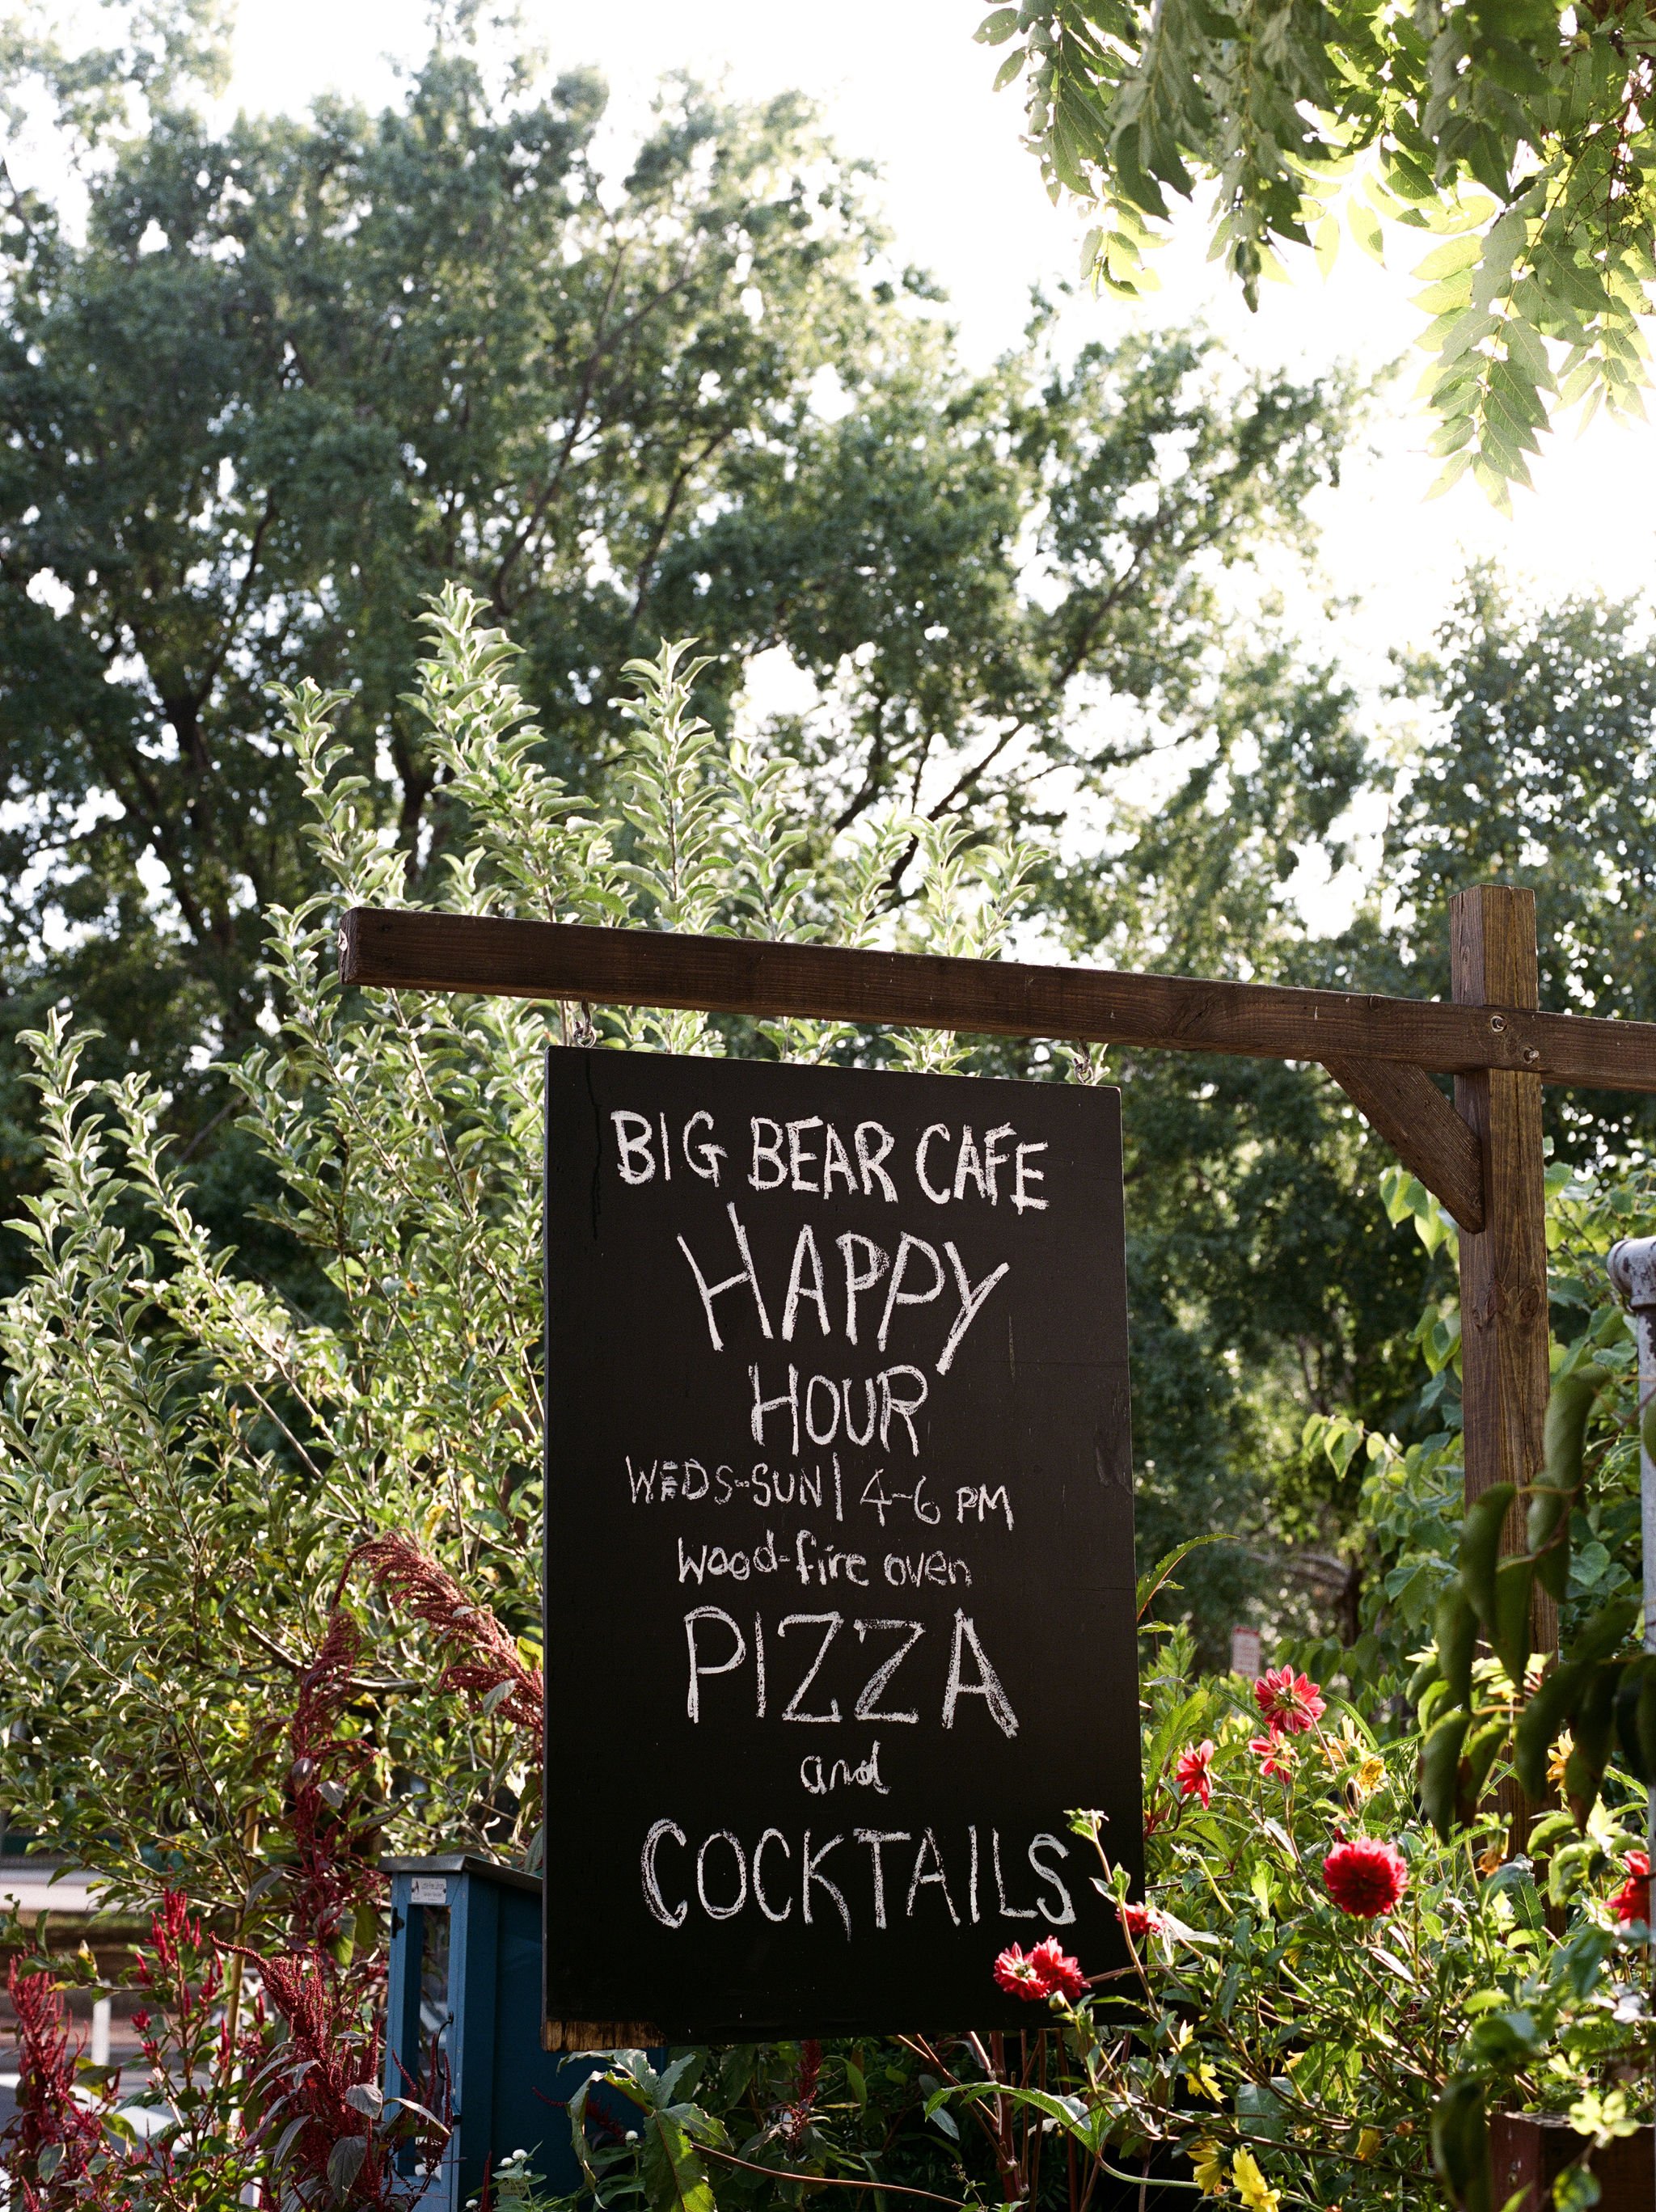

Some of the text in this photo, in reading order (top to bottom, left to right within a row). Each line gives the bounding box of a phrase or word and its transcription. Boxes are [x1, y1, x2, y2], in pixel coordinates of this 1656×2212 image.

[610, 1109, 1050, 1216] BIG BEAR CAFE
[676, 1201, 1011, 1376] HAPPY
[748, 1361, 929, 1458] HOUR
[860, 1468, 941, 1527] 4-6
[955, 1483, 1016, 1532] PM
[883, 1550, 973, 1588] oven
[682, 1605, 1020, 1739] PIZZA
[800, 1740, 890, 1795] and
[640, 1817, 1076, 1942] COCKTAILS
